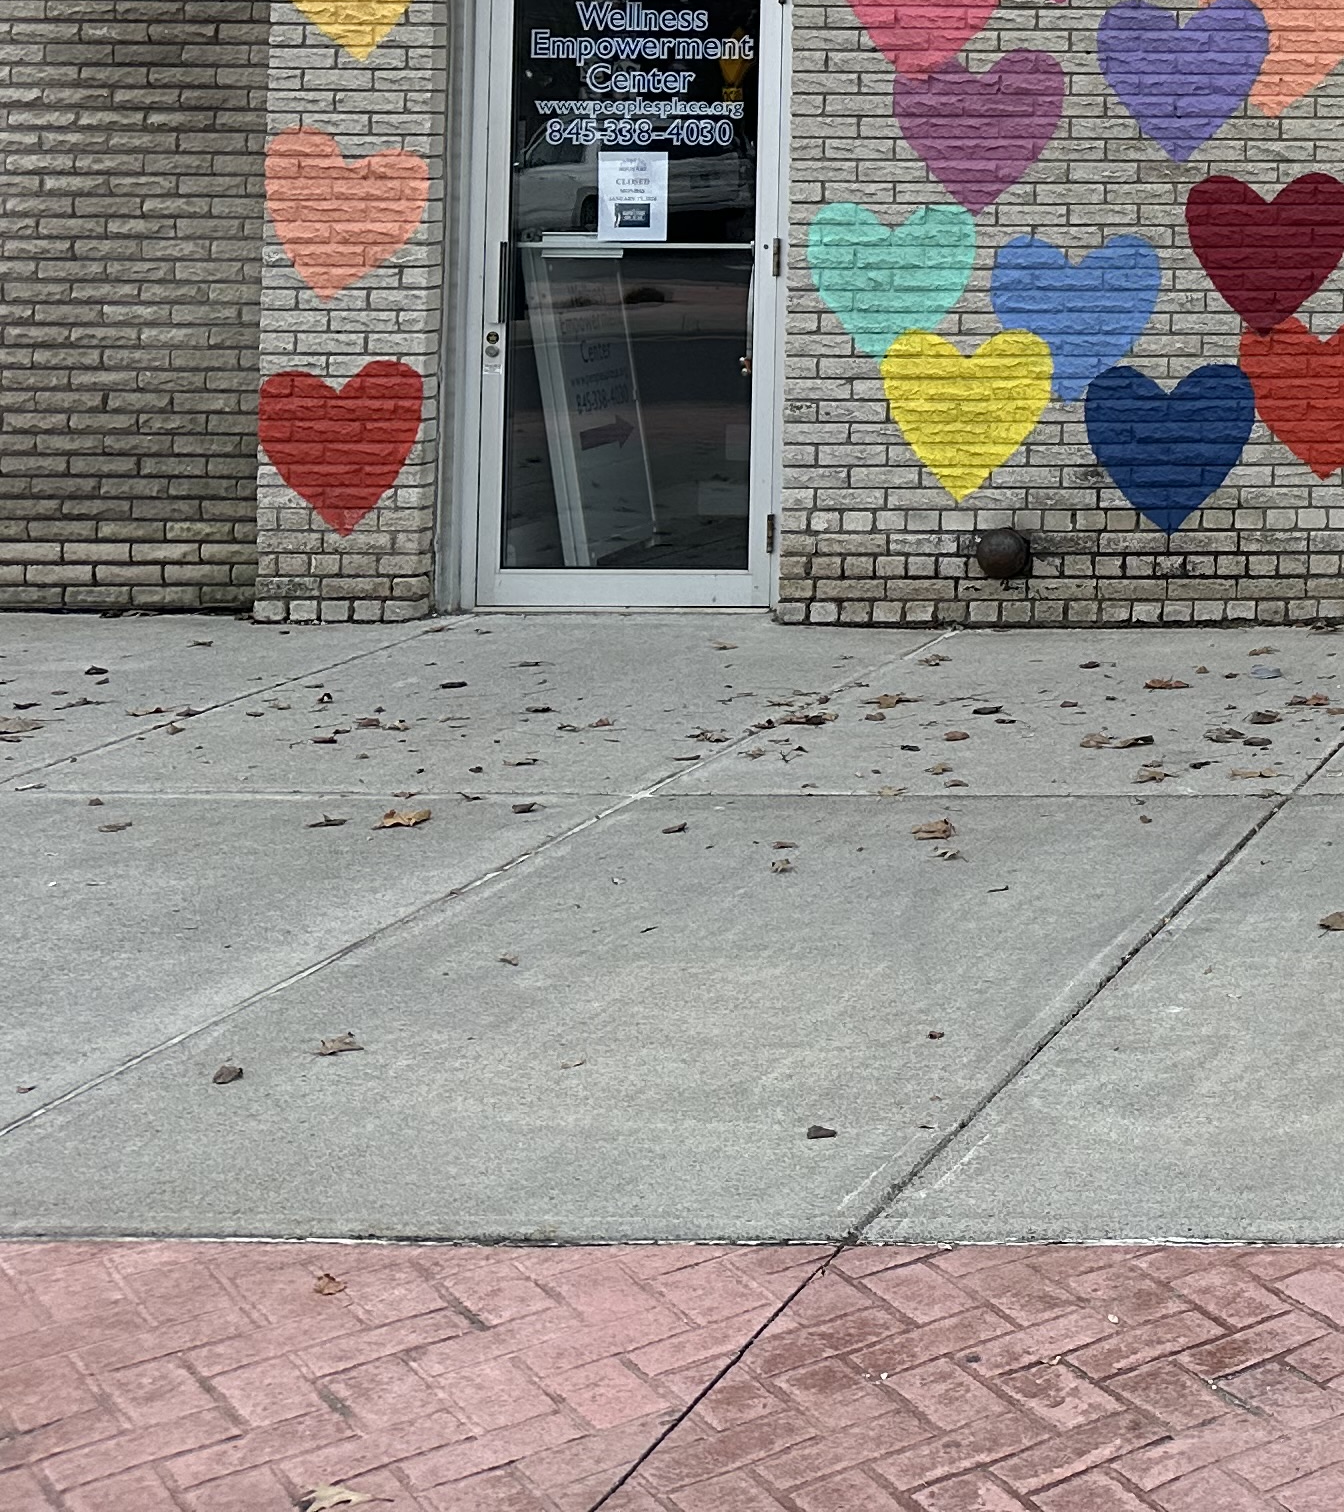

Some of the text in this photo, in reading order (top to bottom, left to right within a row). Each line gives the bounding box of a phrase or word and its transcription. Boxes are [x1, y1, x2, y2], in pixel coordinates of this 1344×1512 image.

[575, 0, 708, 31] Wellness
[530, 29, 754, 67] Empowerment
[586, 62, 696, 93] Center
[535, 97, 744, 120] www.peoplesplace.org
[546, 118, 734, 146] 845-338-4030
